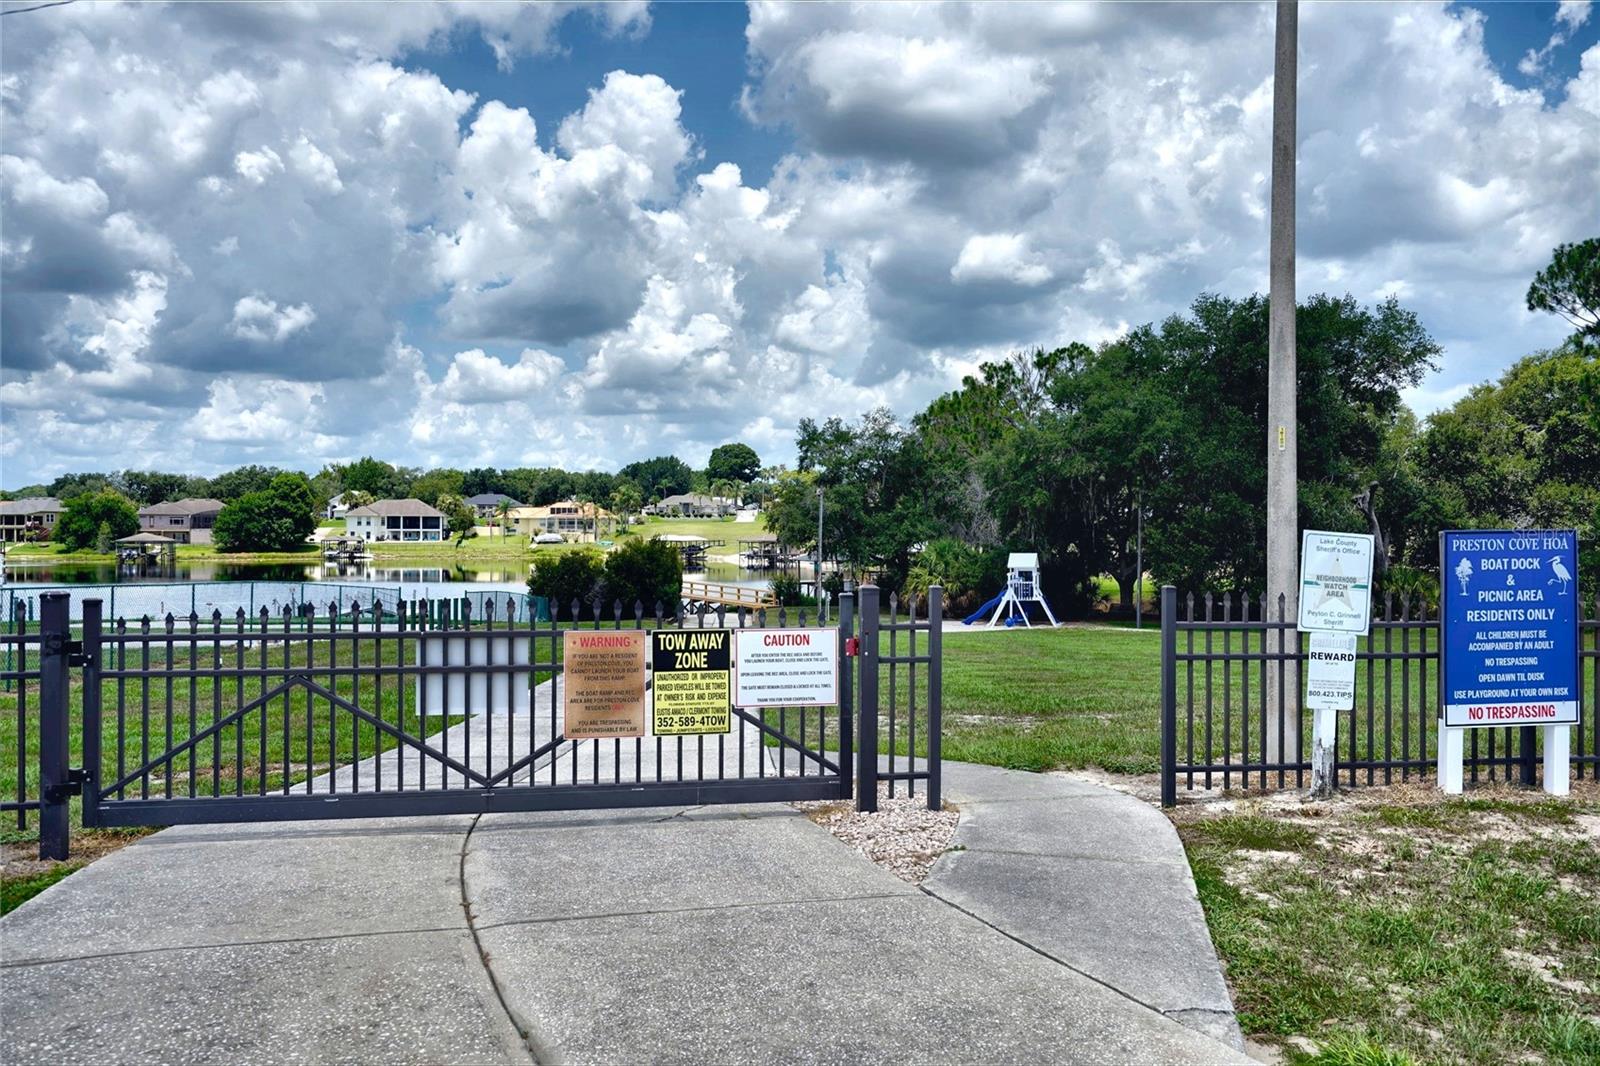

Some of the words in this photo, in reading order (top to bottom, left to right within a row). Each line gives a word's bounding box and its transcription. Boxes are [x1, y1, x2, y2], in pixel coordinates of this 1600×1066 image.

[1453, 539, 1505, 551] PRESTON
[1509, 538, 1539, 550] COVE
[1543, 538, 1568, 550] HOA
[1481, 558, 1509, 570] BOAT
[1511, 558, 1540, 570] DOCK
[1316, 575, 1357, 583] NEIGHBORHOOD
[1506, 574, 1515, 586] &
[1478, 590, 1514, 602] PICNIC
[1516, 590, 1543, 601] AREA
[1467, 609, 1525, 622] RESIDENTS
[1527, 608, 1555, 620] ONLY
[764, 634, 810, 646] CAUTION
[1476, 632, 1487, 640] ALL
[1488, 631, 1519, 639] CHILDREN
[1520, 630, 1537, 639] MUST
[1539, 630, 1547, 638] BE
[580, 636, 631, 648] WARNING
[658, 634, 686, 650] TOW
[689, 633, 724, 650] AWAY
[1469, 642, 1514, 651] ACCOMPANIED
[1515, 642, 1523, 650] BY
[1524, 642, 1533, 650] AN
[1534, 641, 1554, 649] ADULT
[675, 652, 708, 668] ZONE
[1311, 652, 1354, 662] REWARD
[1485, 658, 1495, 667] NO
[1496, 657, 1538, 666] TRESPASSING
[1479, 674, 1496, 682] OPEN
[1497, 673, 1516, 682] DAWN
[1527, 672, 1545, 681] DUSK
[1454, 690, 1467, 699] USE
[1468, 689, 1510, 698] PLAYGROUND
[1520, 688, 1536, 696] YOUR
[1538, 688, 1553, 696] OWN
[1554, 687, 1568, 696] RISK
[1469, 707, 1483, 720] NO
[1486, 705, 1556, 719] TRESPASSING
[657, 716, 726, 727] 352-589-4TOW
